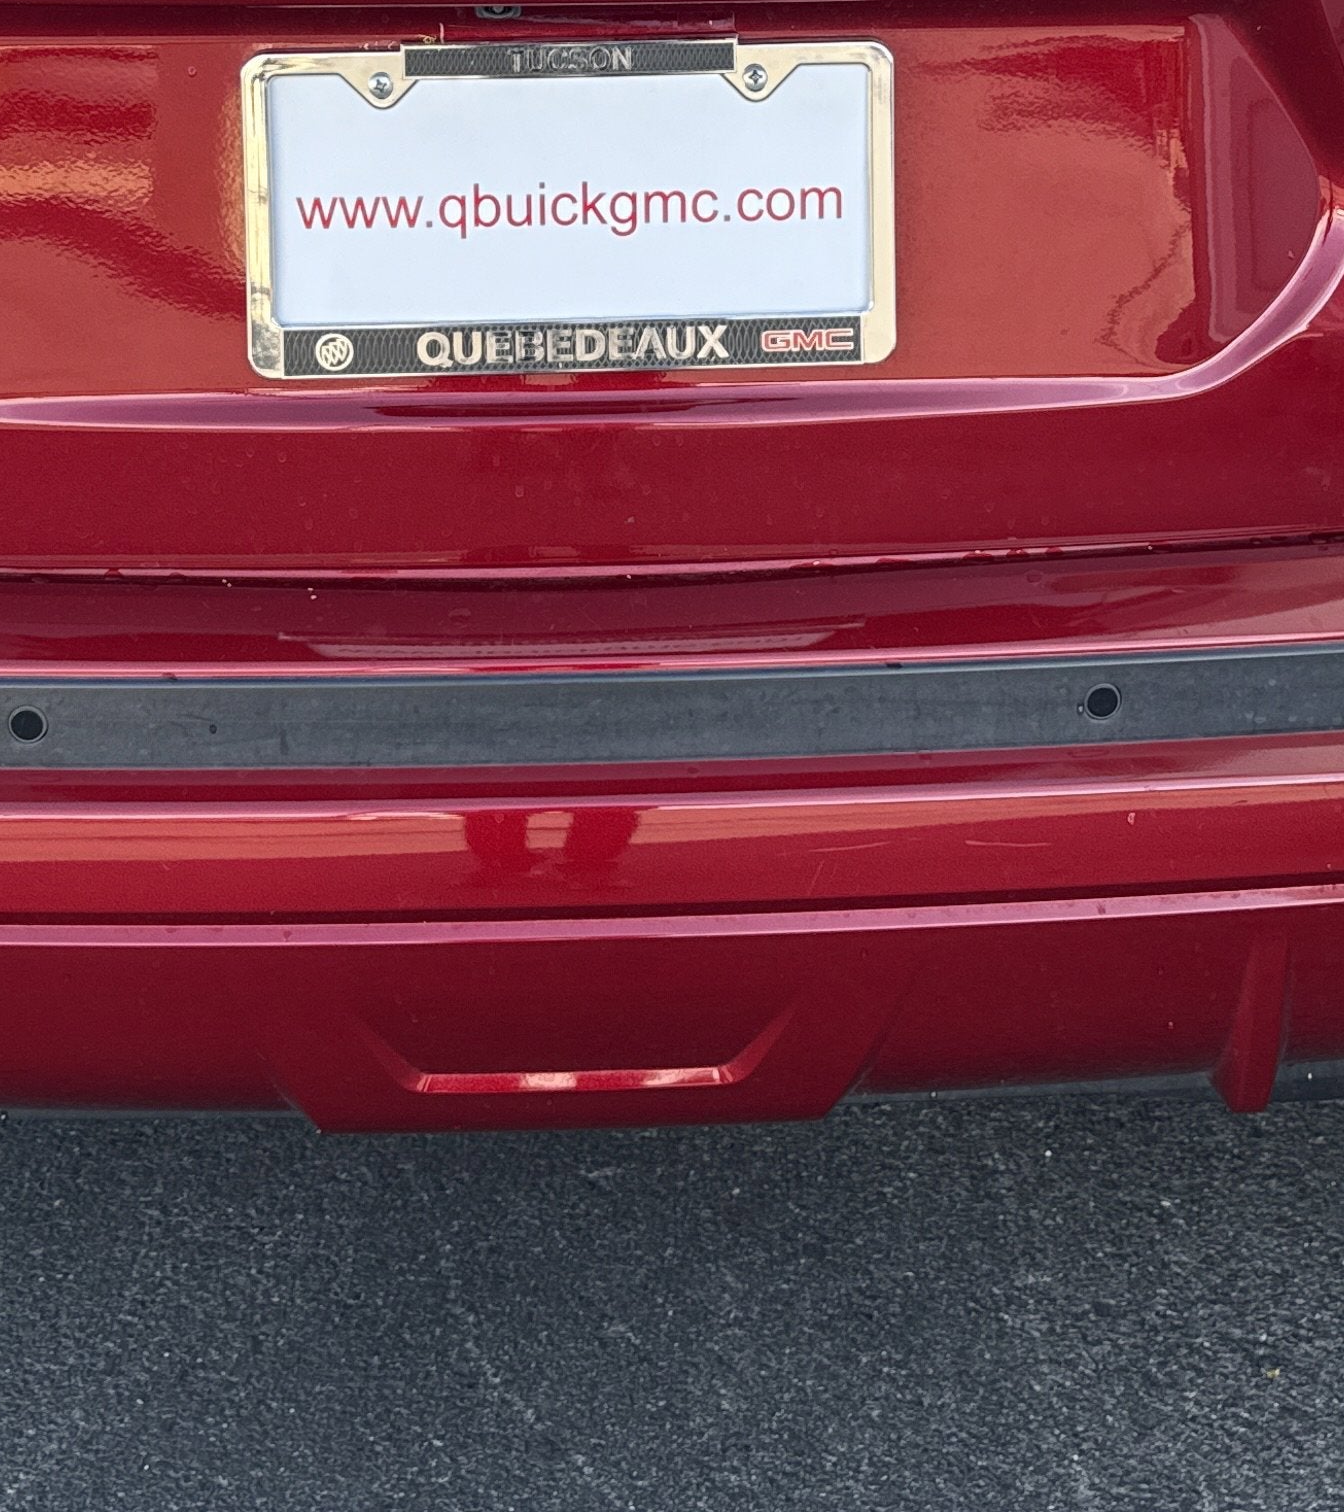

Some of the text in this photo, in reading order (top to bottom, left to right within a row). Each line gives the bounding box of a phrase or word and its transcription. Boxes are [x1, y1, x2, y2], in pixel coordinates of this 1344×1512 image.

[507, 46, 633, 73] TUCSON
[296, 181, 843, 239] www.qbuickgmc.com
[416, 324, 855, 368] QUEBEDEAUX GMC
